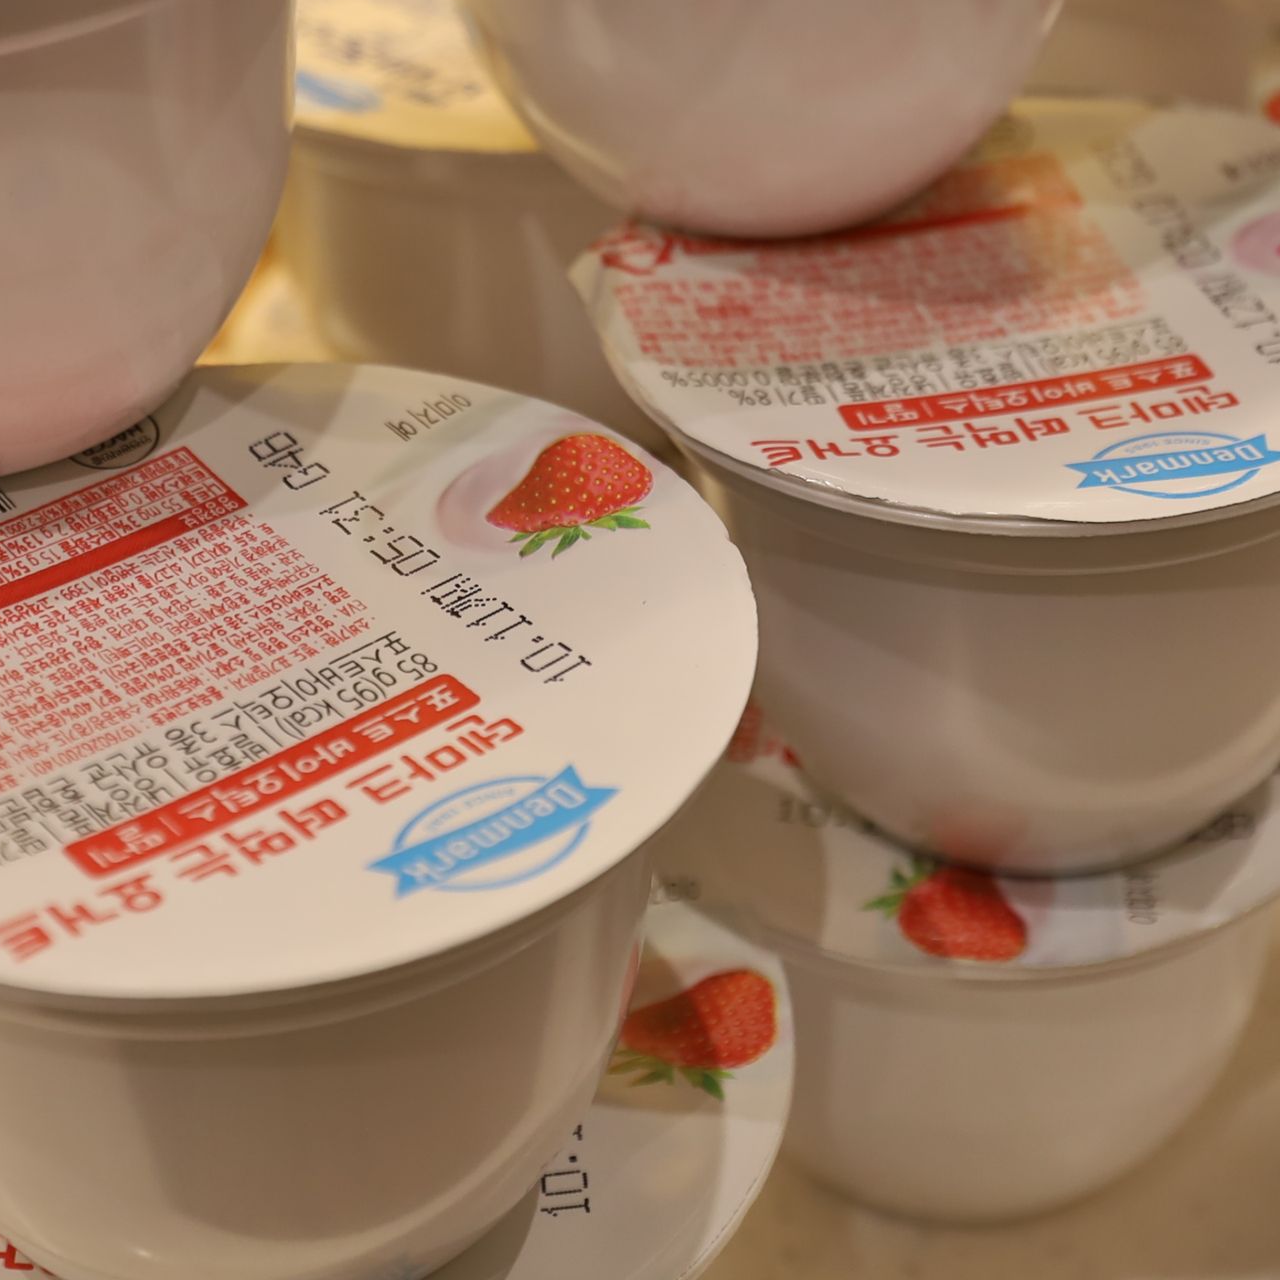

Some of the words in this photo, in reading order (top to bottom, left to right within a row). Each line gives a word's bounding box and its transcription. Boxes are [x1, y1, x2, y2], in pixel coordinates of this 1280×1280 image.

[1097, 362, 1200, 391] 포스트
[406, 394, 472, 430] 이미지
[848, 400, 922, 426] 딸기
[935, 379, 1101, 416] 바이오틱스
[1073, 382, 1244, 430] 덴마크
[384, 420, 418, 443] 예
[748, 432, 913, 467] 요거트
[906, 412, 1076, 455] 떠먹는
[1092, 443, 1265, 485] Denmark
[175, 493, 241, 529] 영양정보
[4, 532, 44, 555] 13%
[55, 524, 120, 557] 탄수화물
[319, 490, 440, 577] 05:31
[56, 579, 96, 602] 1399
[241, 573, 337, 622] 포스트바이오틱스
[334, 598, 369, 618] EVA
[184, 621, 230, 646] 유산균
[317, 616, 374, 648] 소비기한
[205, 630, 415, 736] 포스트바이오틱스
[224, 653, 295, 690] 표기일까지
[391, 651, 442, 681] 85
[269, 696, 348, 742] kcal)
[349, 683, 464, 746] 포스트
[162, 719, 219, 755] 3종
[76, 739, 173, 794] 유산균
[178, 730, 272, 787] 발효유
[340, 704, 529, 811] 덴마크
[174, 734, 361, 831] 바이오틱스
[50, 772, 174, 841] 냉장제품
[80, 816, 171, 871] 딸기
[171, 790, 351, 886] 떠먹는
[402, 784, 587, 887] Denmark
